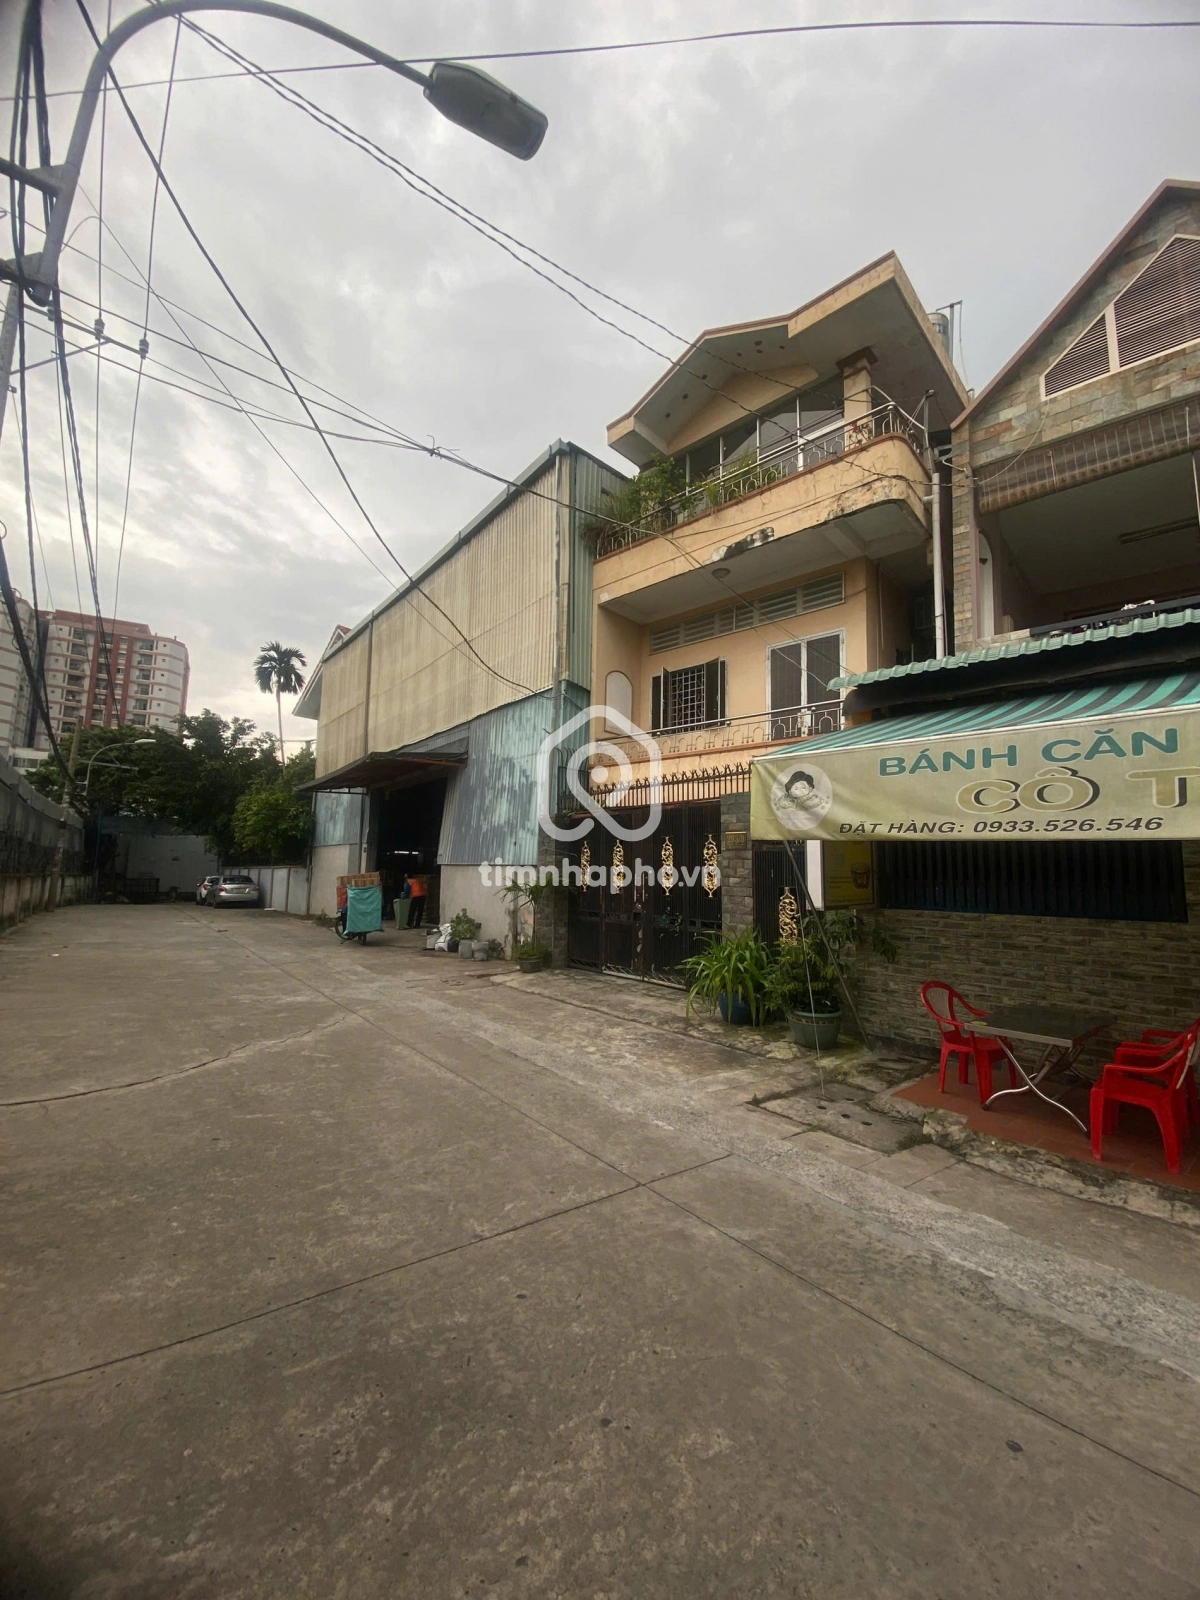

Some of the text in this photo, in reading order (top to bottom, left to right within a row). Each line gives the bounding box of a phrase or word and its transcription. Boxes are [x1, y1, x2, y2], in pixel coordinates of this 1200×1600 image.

[879, 727, 1179, 777] BÁNH CĂN
[955, 765, 1101, 815] CÔ
[839, 817, 1164, 836] ĐẶT HÀNG: 0933.526.546
